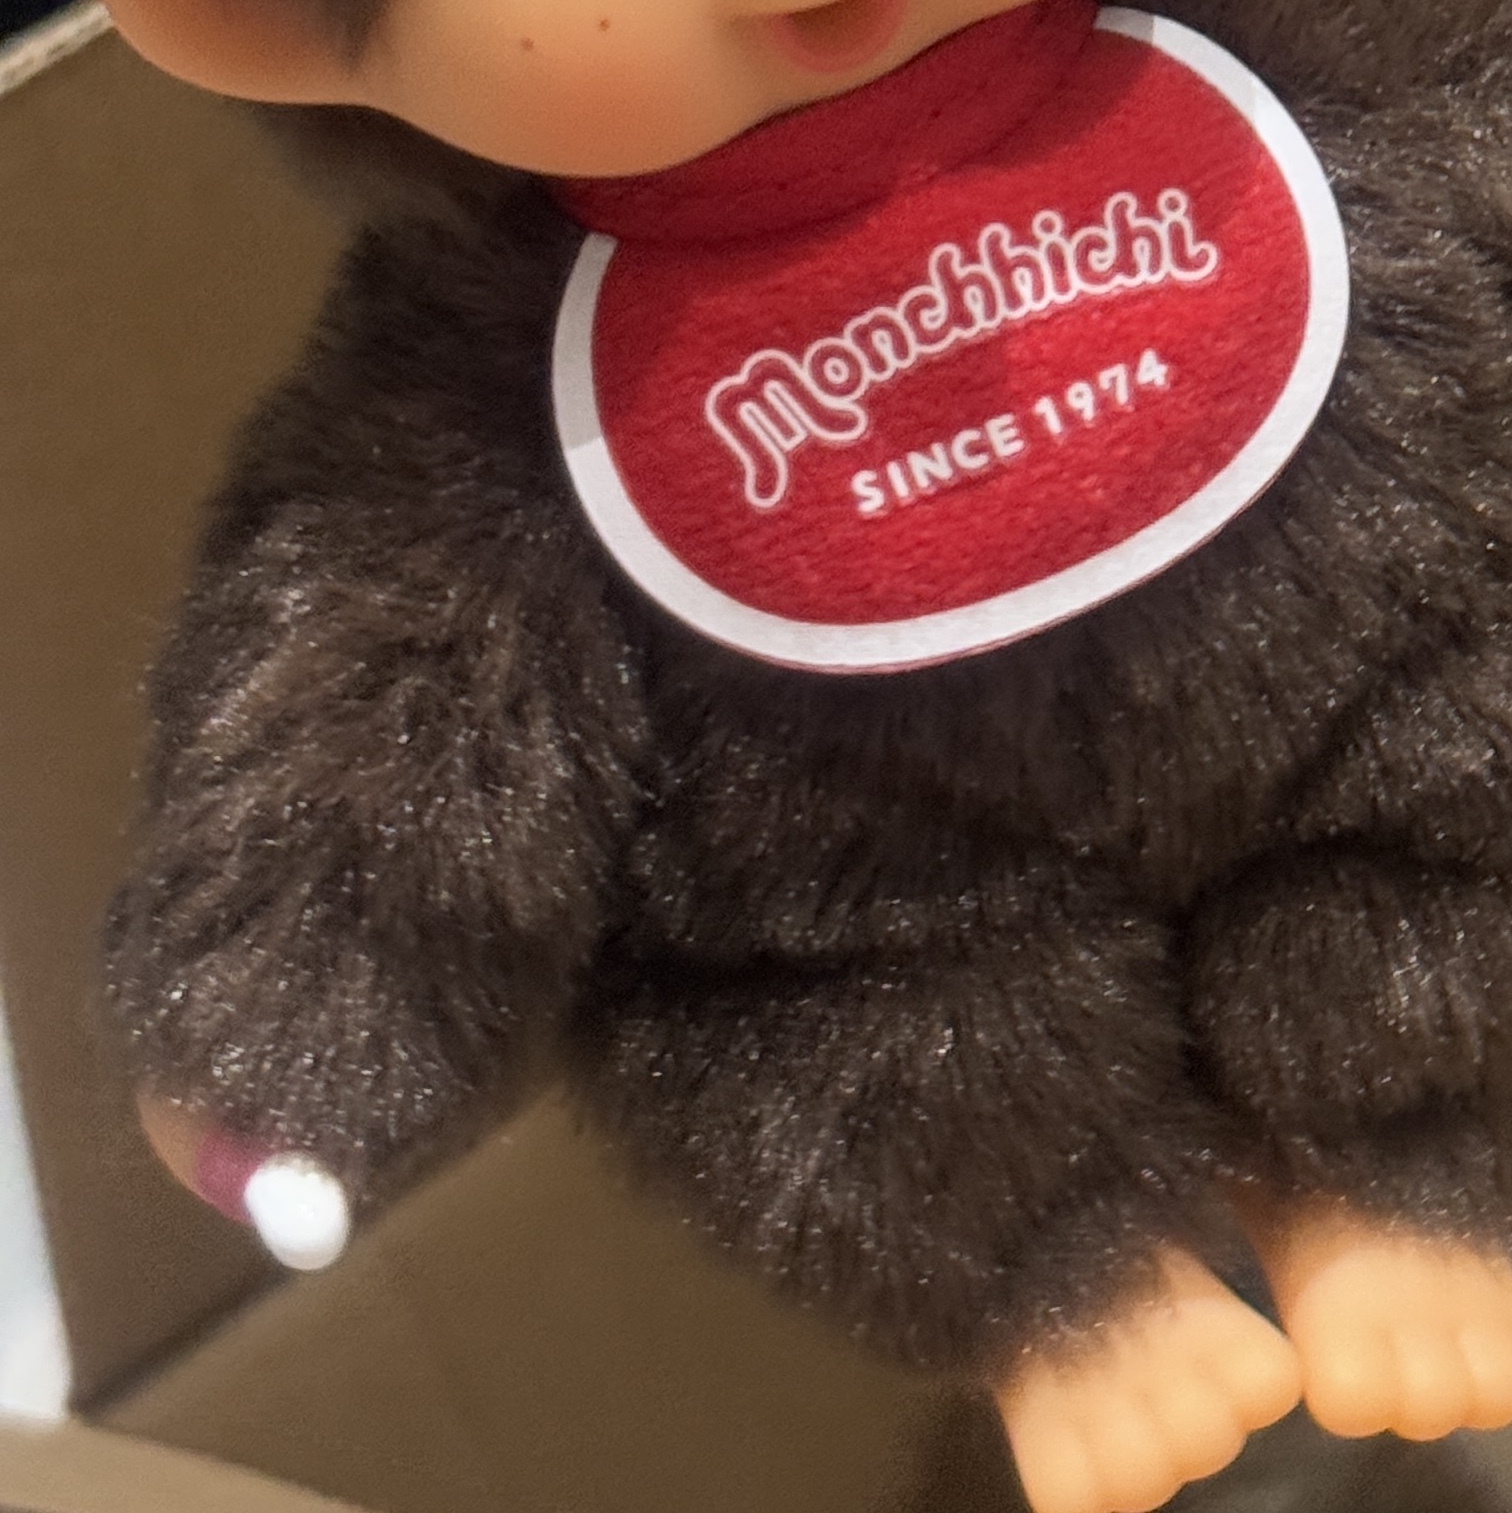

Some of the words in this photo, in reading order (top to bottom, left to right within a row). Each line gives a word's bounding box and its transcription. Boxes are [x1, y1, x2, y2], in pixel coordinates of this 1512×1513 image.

[706, 188, 1218, 508] Monchhichi
[851, 414, 1024, 515] SINCE
[1033, 349, 1170, 436] 1974
